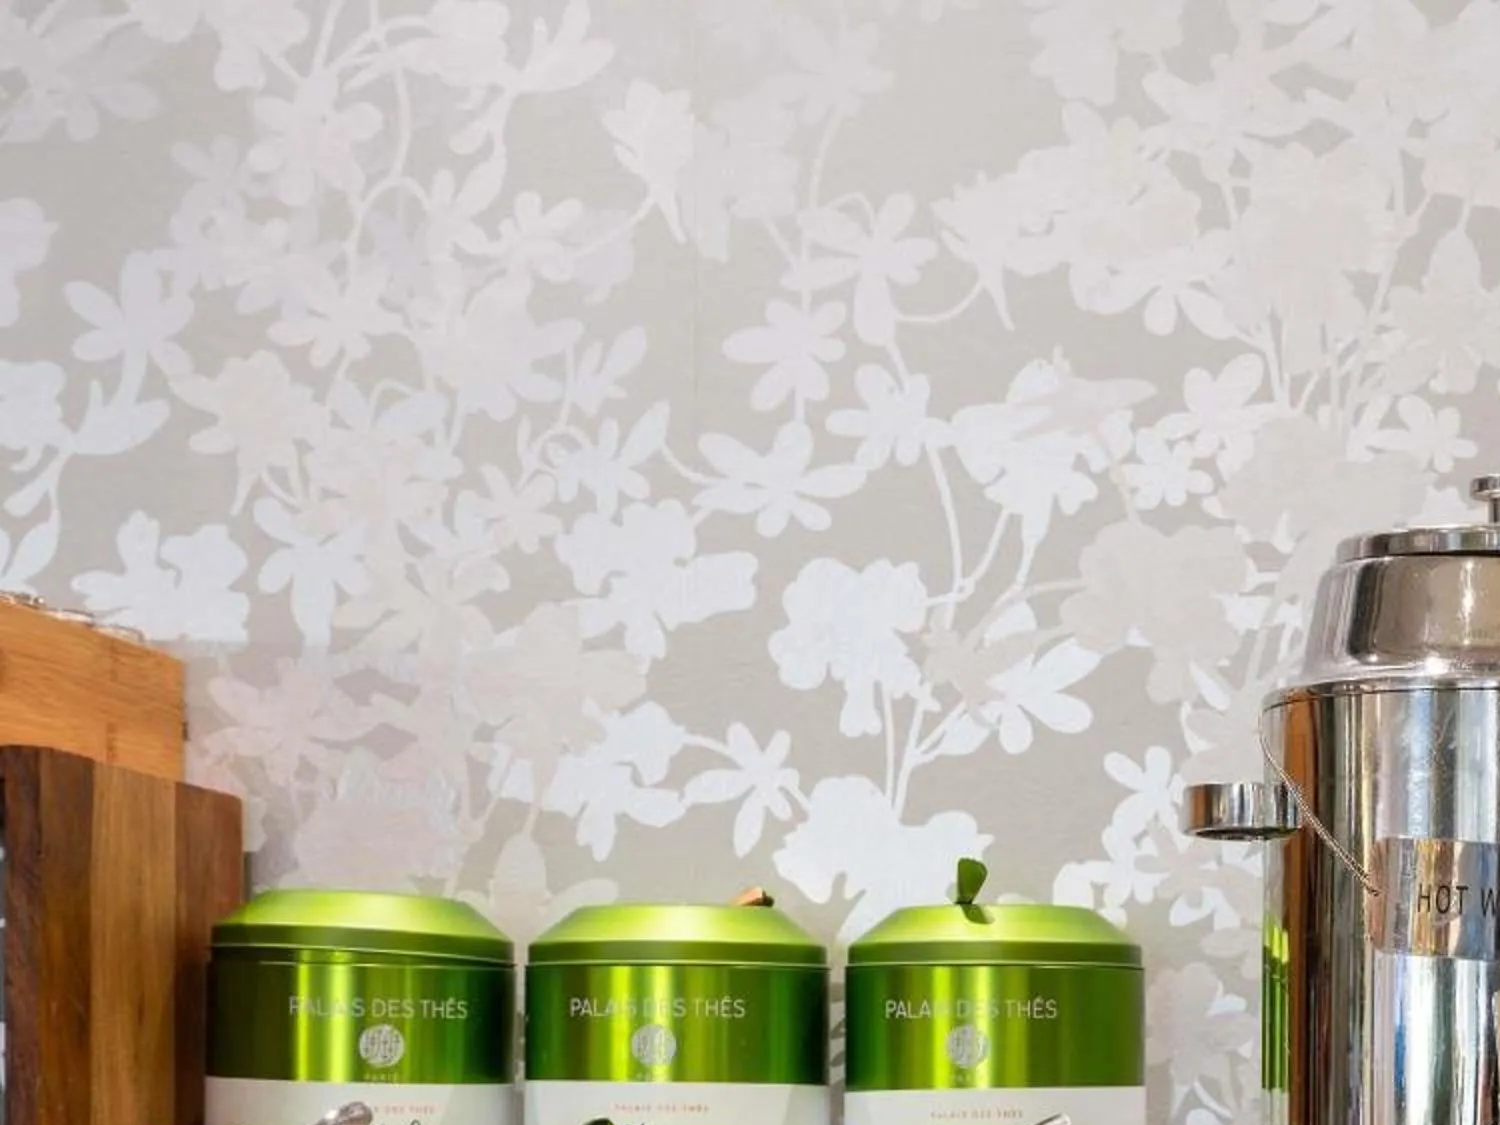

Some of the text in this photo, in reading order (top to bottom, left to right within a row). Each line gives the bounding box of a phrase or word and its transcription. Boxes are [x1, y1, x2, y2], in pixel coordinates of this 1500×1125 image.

[1417, 884, 1469, 915] HOT
[289, 996, 468, 1020] PALAS DES THÉS
[569, 998, 637, 1018] PALAS
[694, 995, 747, 1018] THÉS
[885, 999, 949, 1019] PALA
[1006, 996, 1058, 1019] THÉS
